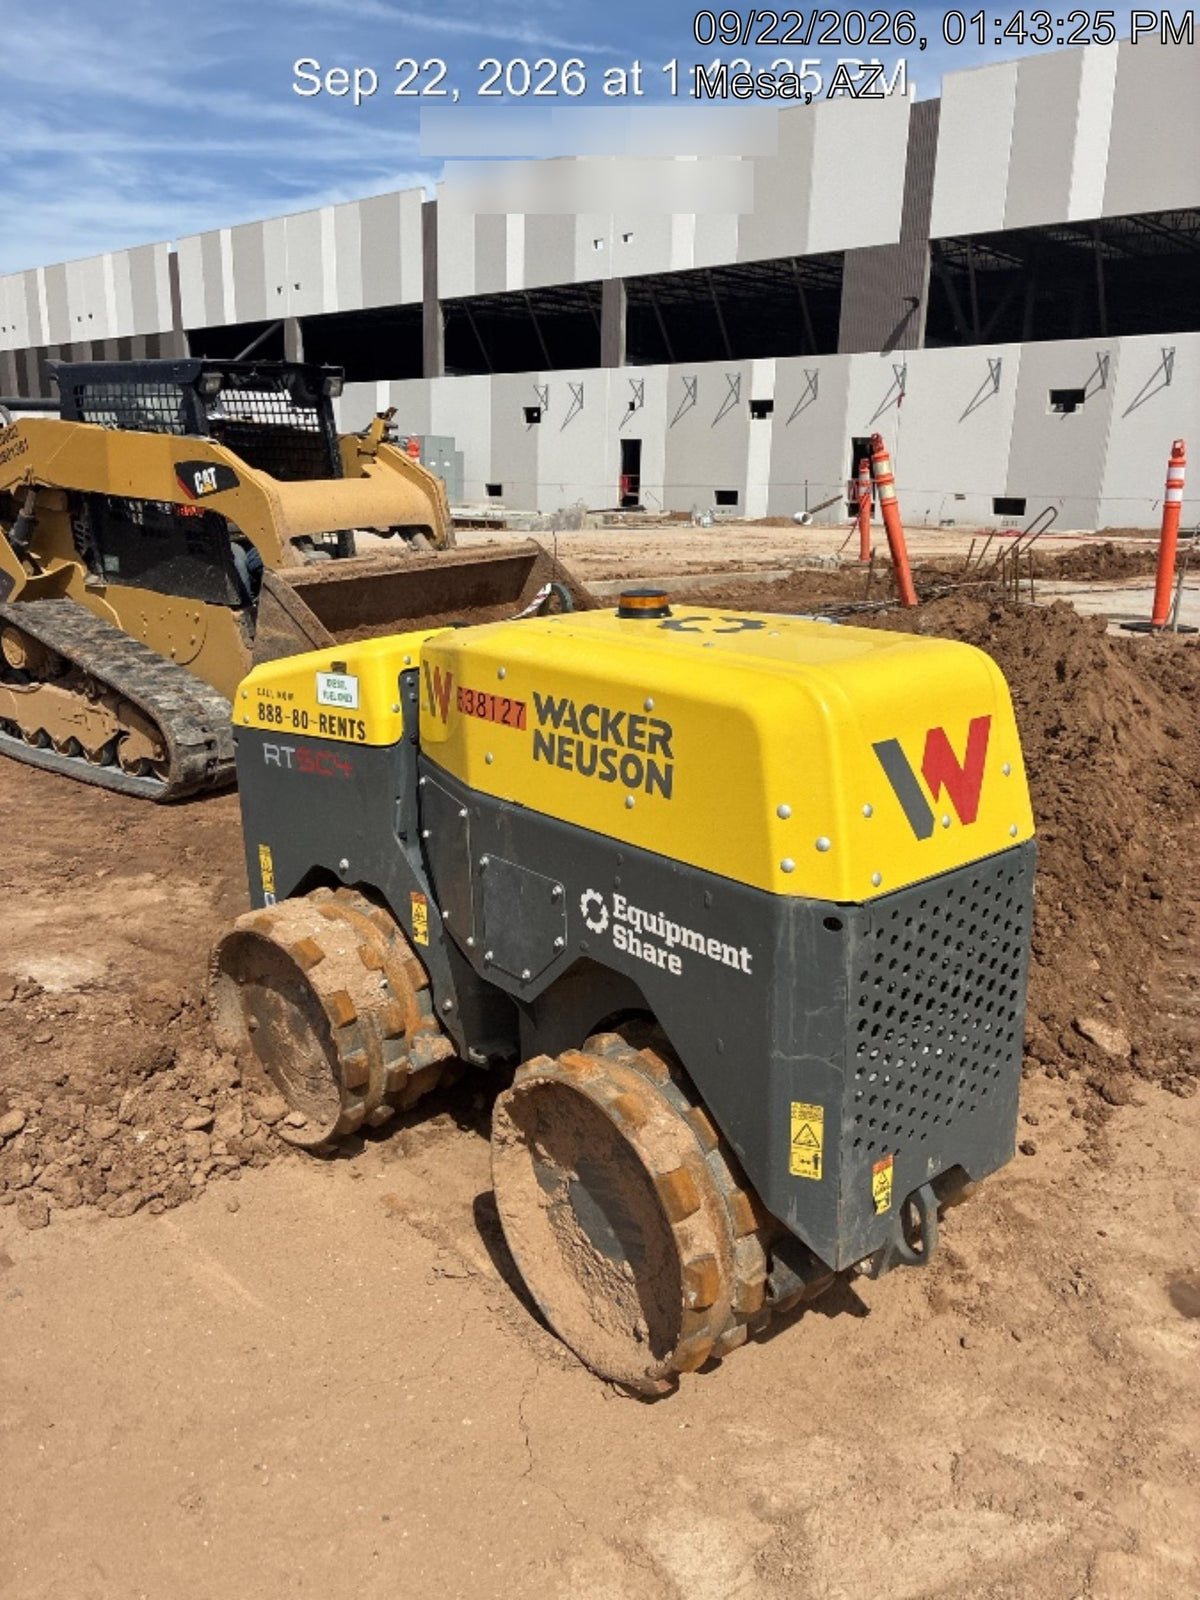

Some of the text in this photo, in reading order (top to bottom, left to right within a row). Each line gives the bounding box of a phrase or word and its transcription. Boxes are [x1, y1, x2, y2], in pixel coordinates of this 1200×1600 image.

[193, 467, 218, 495] CAT
[258, 702, 367, 741] 888-80-RENTS
[532, 691, 675, 760] WACKER
[532, 728, 674, 801] NEUSON
[612, 892, 753, 976] Equipment
[612, 923, 683, 976] Share
